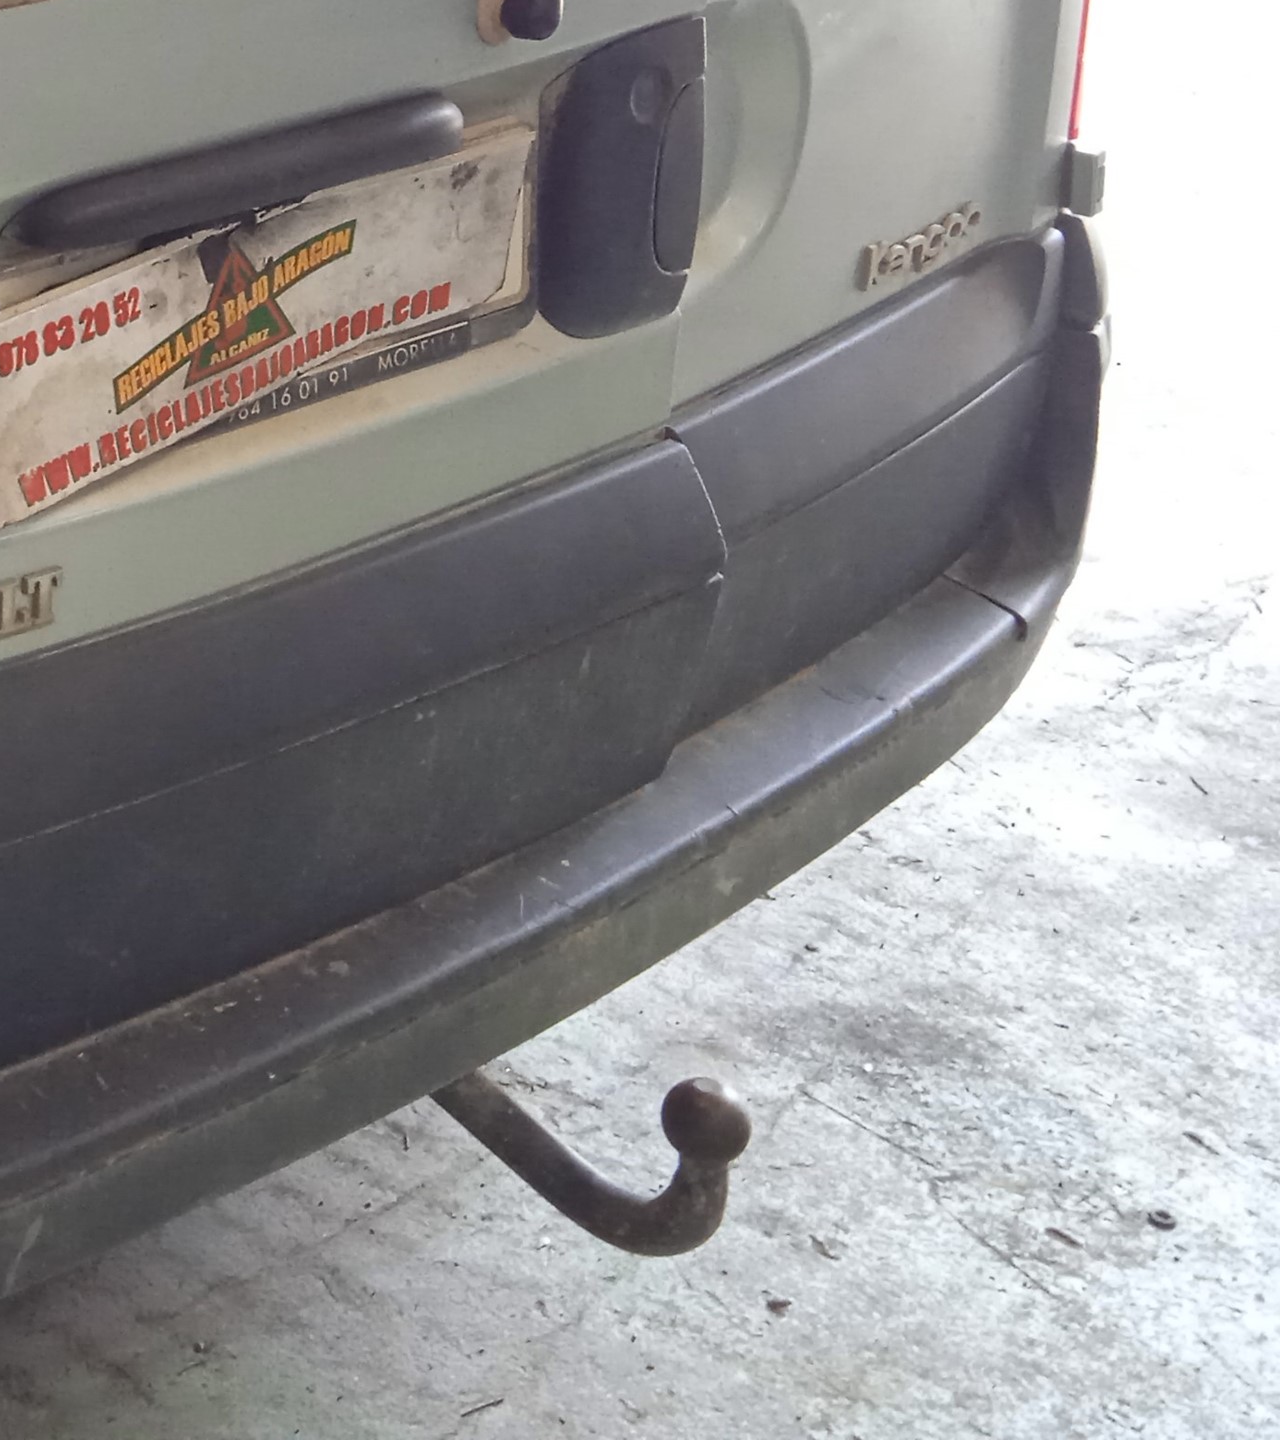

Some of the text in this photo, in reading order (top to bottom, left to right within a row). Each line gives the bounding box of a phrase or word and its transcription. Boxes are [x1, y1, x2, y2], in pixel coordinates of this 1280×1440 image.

[42, 314, 76, 357] 83
[78, 300, 111, 344] 20
[112, 286, 142, 328] 52
[116, 227, 353, 406] RECICLAJES BAJO ARAGÓN
[17, 281, 452, 508] WWW.RECICLAJESBAJOARAGON.COM
[271, 386, 292, 410] 16
[298, 377, 319, 400] 01
[328, 366, 349, 387] 91
